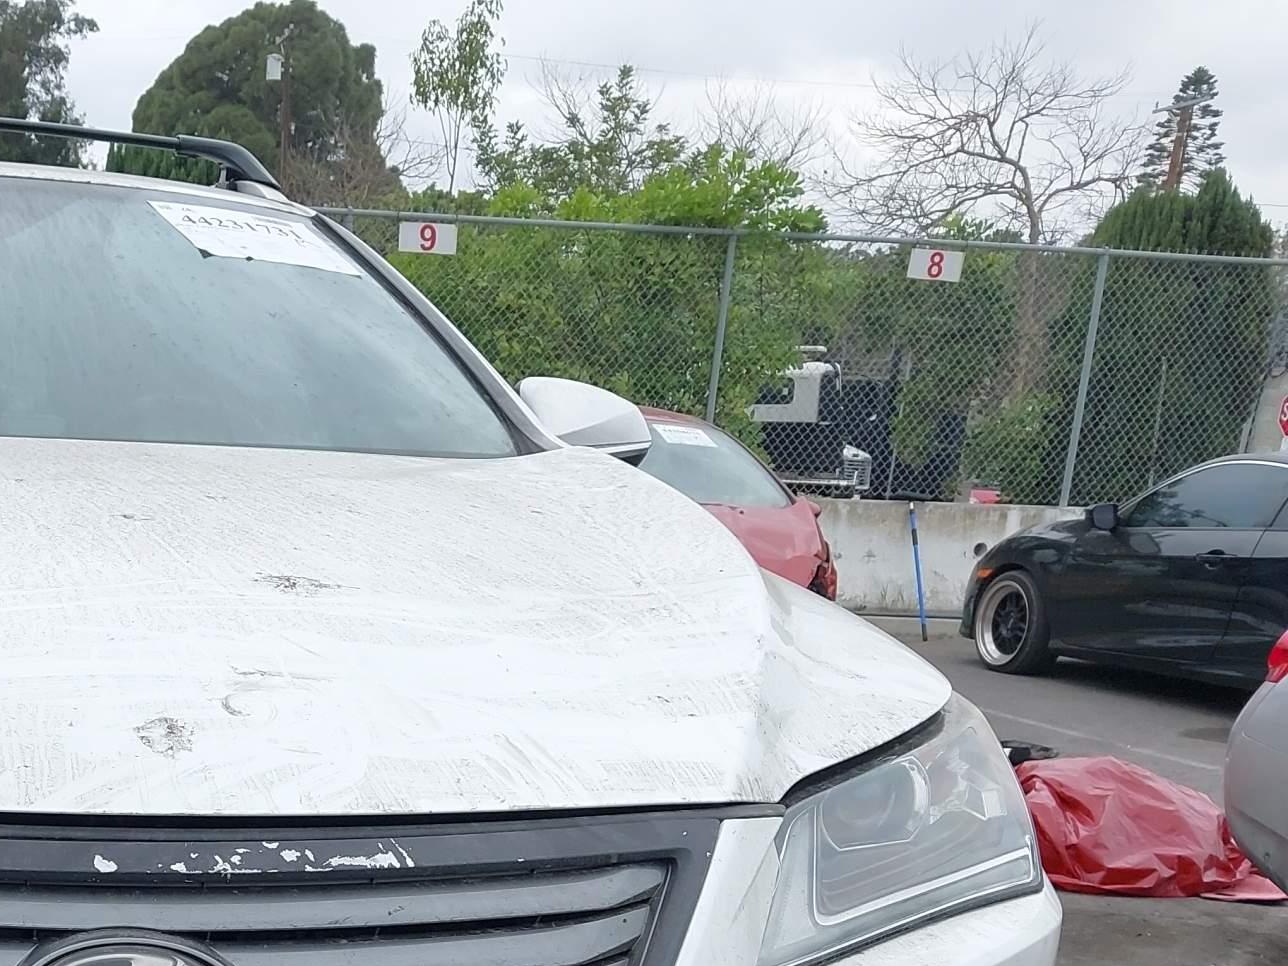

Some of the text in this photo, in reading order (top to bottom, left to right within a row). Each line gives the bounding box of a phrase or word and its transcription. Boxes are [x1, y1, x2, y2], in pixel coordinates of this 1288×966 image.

[182, 214, 304, 240] 44231731
[419, 224, 437, 251] 9
[927, 252, 944, 278] 8
